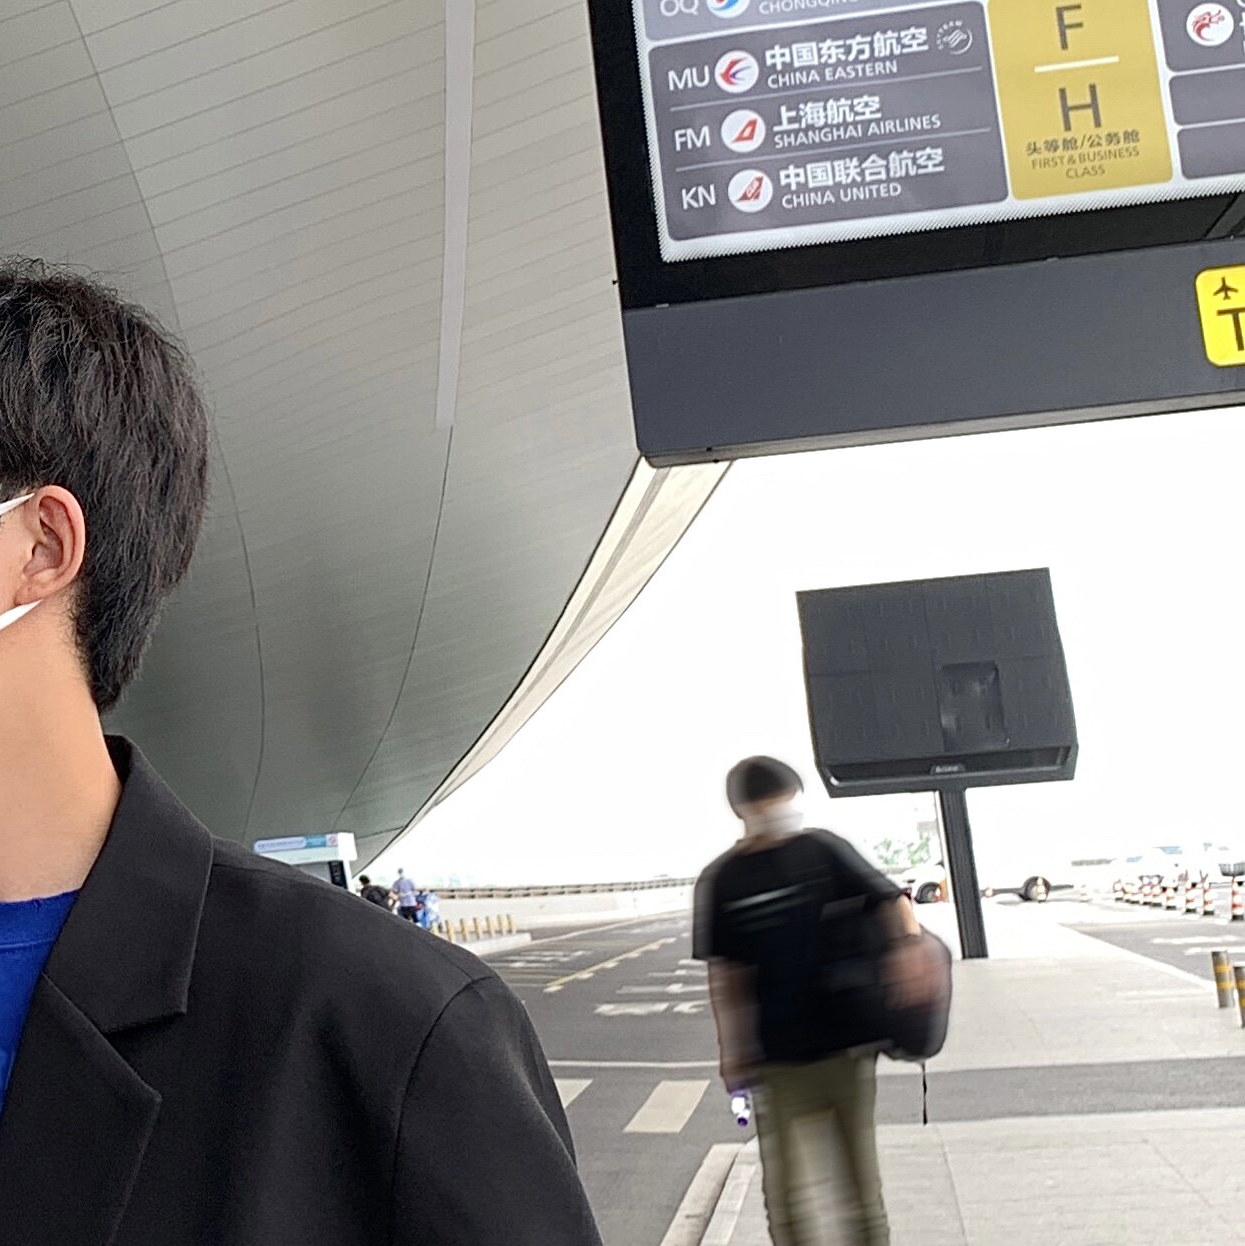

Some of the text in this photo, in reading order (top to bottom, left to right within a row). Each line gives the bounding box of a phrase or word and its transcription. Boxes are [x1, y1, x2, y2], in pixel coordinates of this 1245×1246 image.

[1055, 4, 1084, 50] F
[765, 26, 929, 71] 中国东方航空
[668, 66, 710, 91] MU
[767, 60, 898, 89] CHINA EASTERN
[773, 95, 882, 132] 上海航空
[1058, 83, 1102, 132] H
[674, 126, 711, 151] FM
[773, 114, 941, 149] SHANGHAI AIRLINES
[779, 147, 945, 191] 中国联合航空
[1031, 154, 1066, 170] FIRST
[1078, 145, 1140, 164] BUSINESS
[1065, 164, 1106, 179] CLASS
[681, 184, 717, 209] KN
[781, 182, 902, 209] CHINA UNITED
